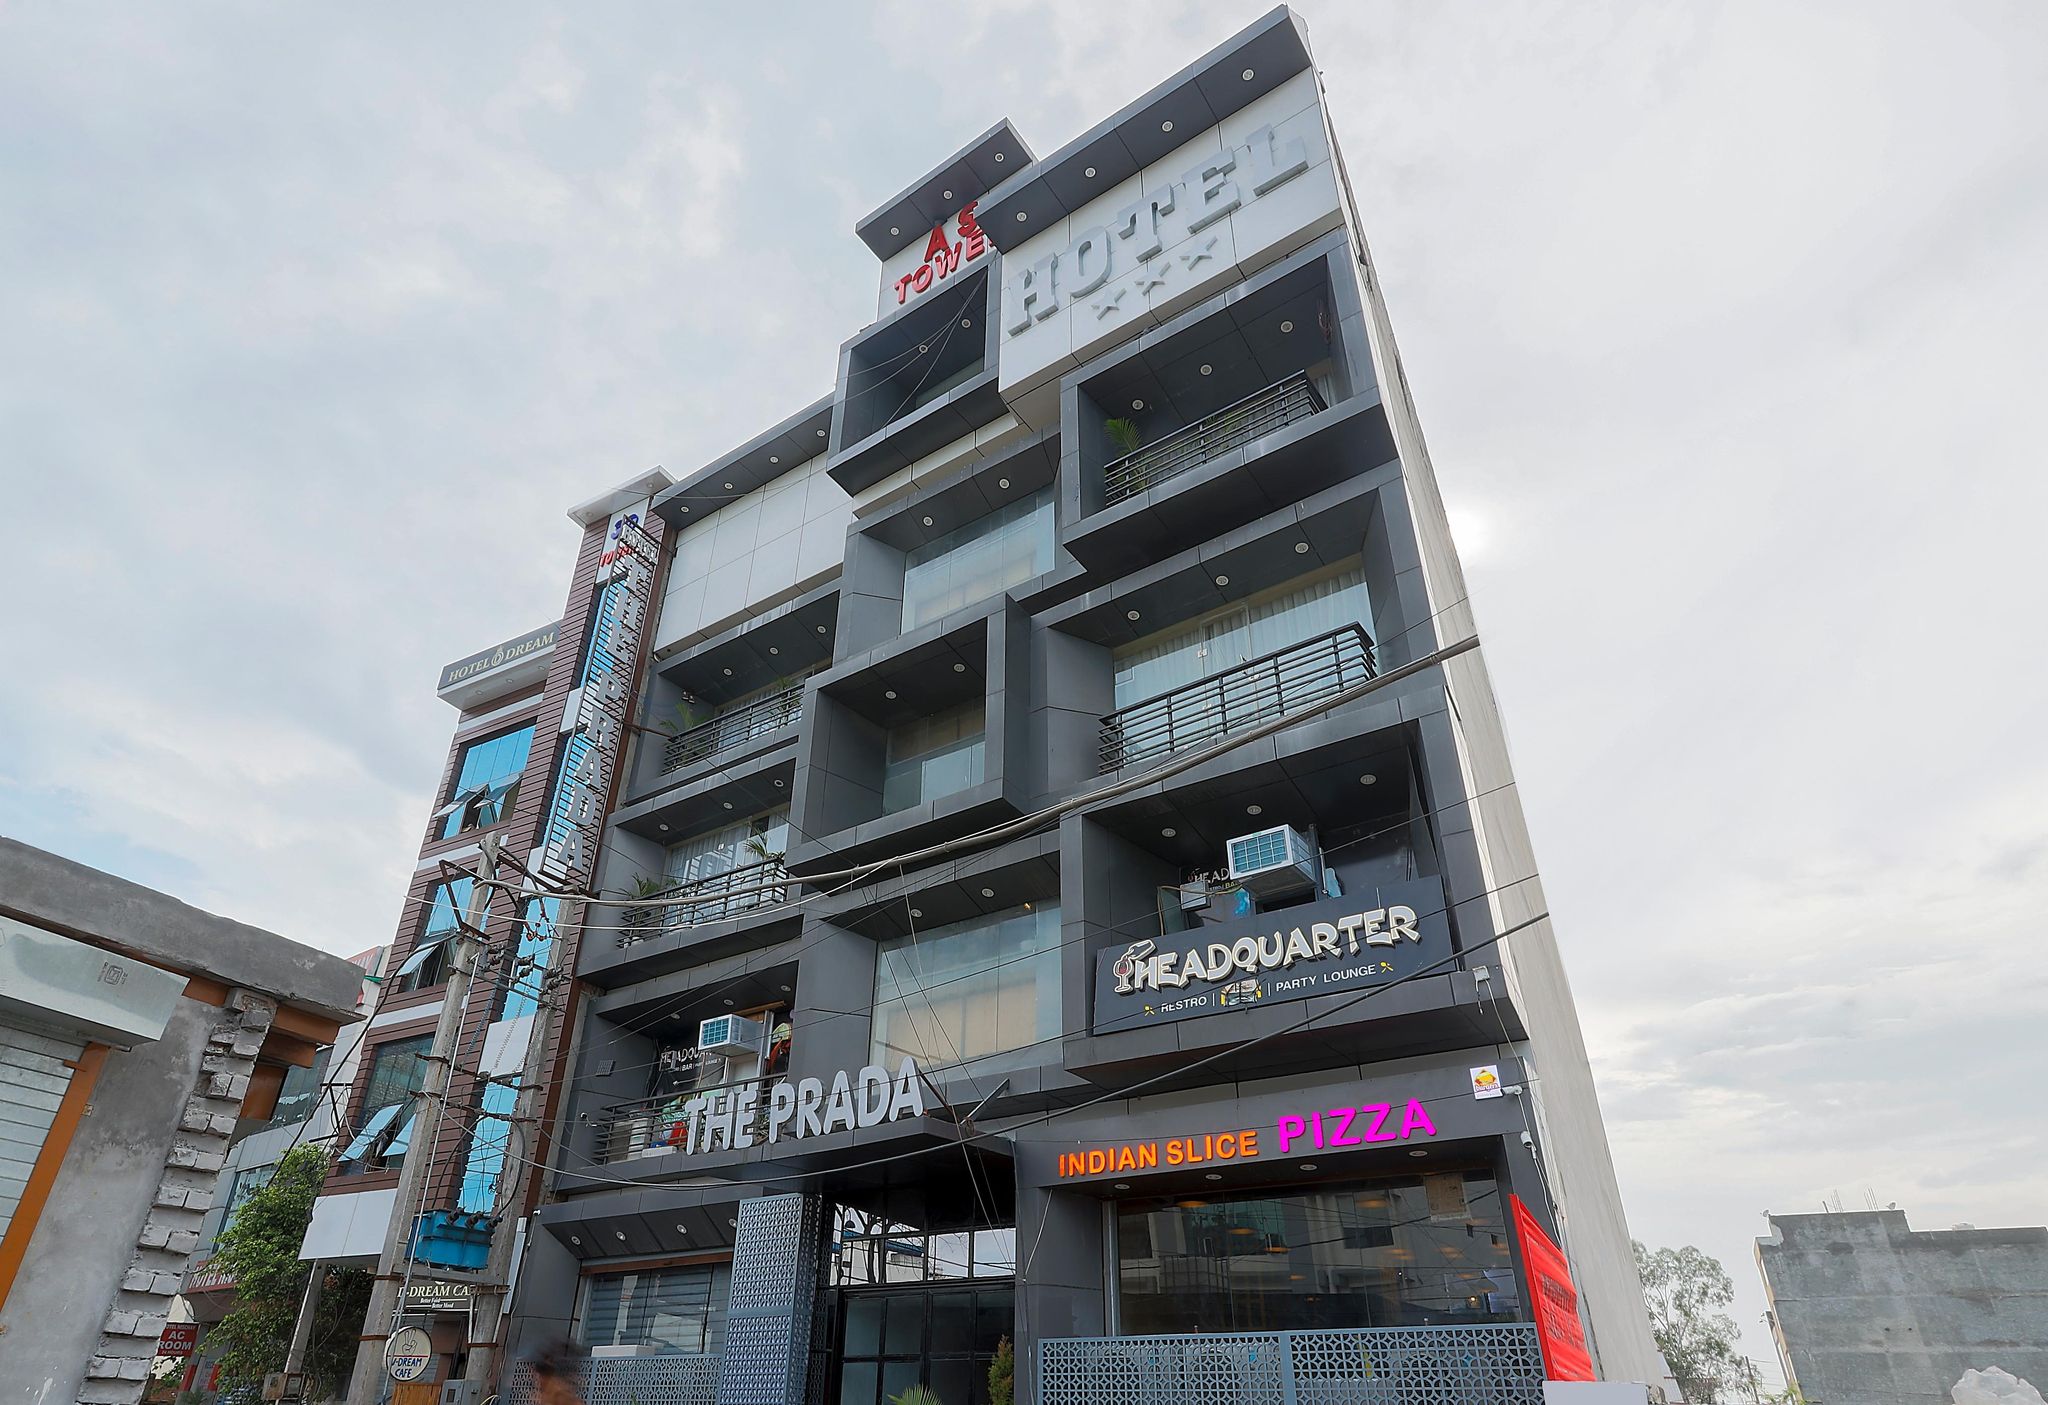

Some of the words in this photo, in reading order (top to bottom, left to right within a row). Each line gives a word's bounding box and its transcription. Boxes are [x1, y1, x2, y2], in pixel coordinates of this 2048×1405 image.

[894, 229, 994, 304] TOWE
[1007, 122, 1309, 337] HOTEL
[606, 553, 651, 663] THE
[448, 657, 491, 683] HOTEL
[505, 632, 554, 660] DREAM
[557, 669, 624, 863] PRADA
[1135, 905, 1420, 990] HEADQUARTER
[1160, 996, 1208, 1013] RESTRO
[1276, 975, 1317, 992] PARTY
[1323, 964, 1376, 983] LOUNGE
[684, 1089, 758, 1156] THE
[768, 1056, 924, 1144] PRADA
[1058, 1142, 1157, 1177] INDIAN
[1165, 1130, 1258, 1166] SLICE
[1278, 1097, 1437, 1153] PIZZA
[159, 1341, 192, 1350] ROOM
[169, 1331, 186, 1340] AC
[395, 1368, 412, 1378] CAFE
